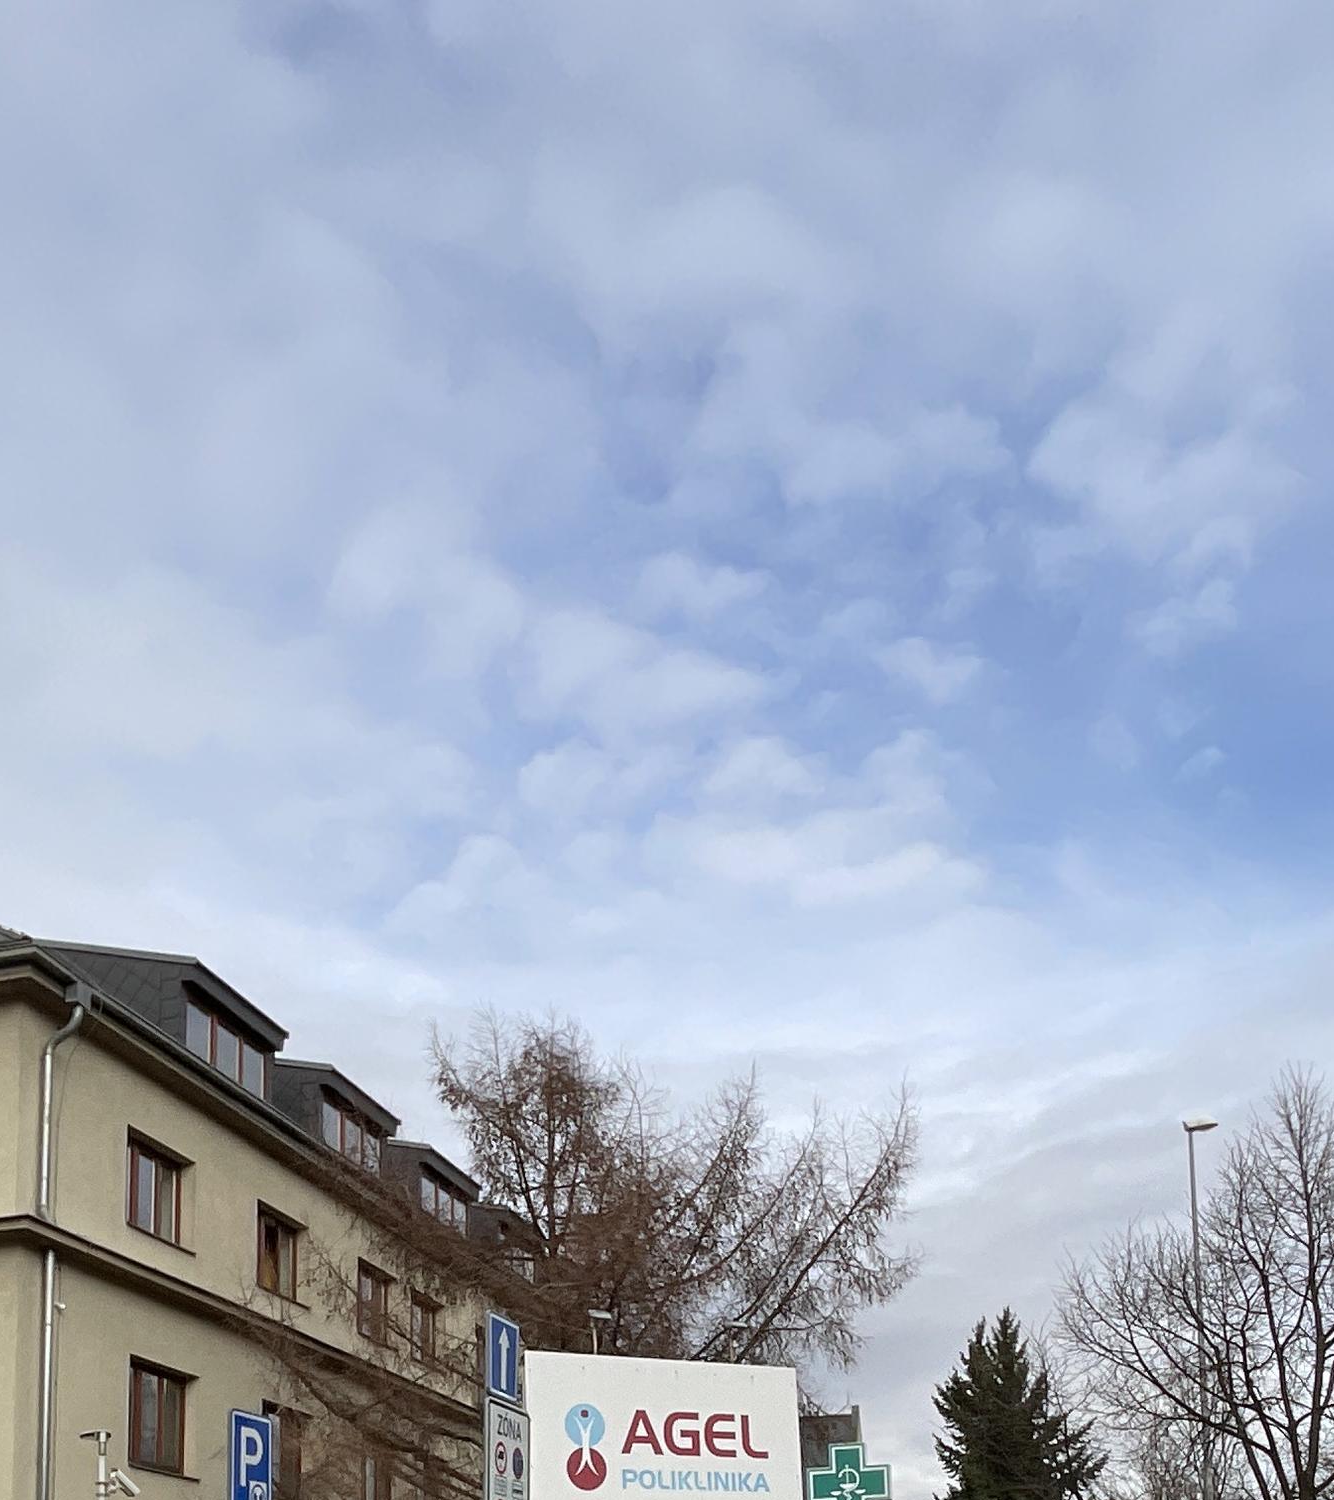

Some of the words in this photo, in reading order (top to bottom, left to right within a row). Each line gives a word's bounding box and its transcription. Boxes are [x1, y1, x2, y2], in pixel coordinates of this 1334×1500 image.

[497, 1413, 522, 1441] ZÓNA
[622, 1410, 768, 1459] AGEL
[239, 1426, 263, 1487] P
[621, 1469, 770, 1492] POLIKLINIKA
